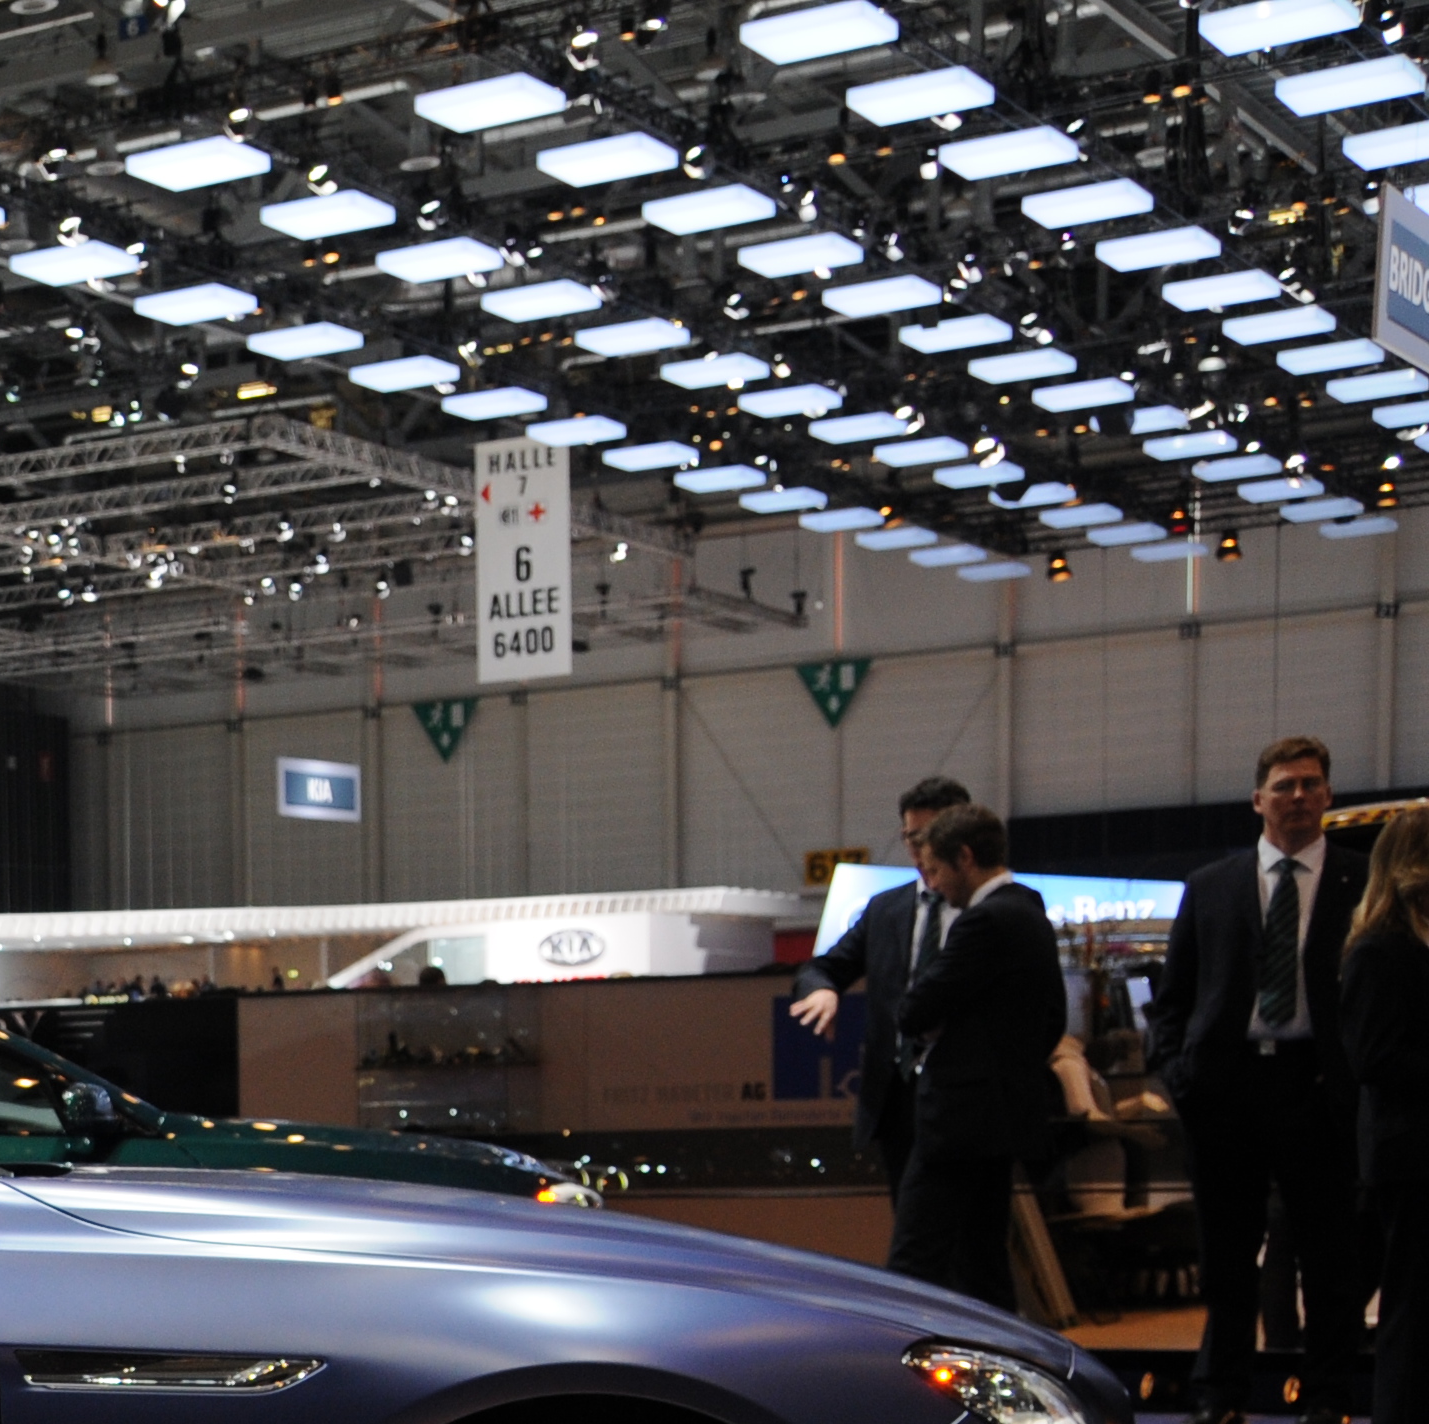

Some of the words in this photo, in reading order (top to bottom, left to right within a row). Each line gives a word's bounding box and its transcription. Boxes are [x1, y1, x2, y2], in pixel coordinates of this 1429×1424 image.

[488, 446, 557, 474] HALLE
[517, 476, 528, 496] 7
[515, 546, 533, 583] 6
[490, 587, 560, 621] ALLEE
[494, 625, 554, 658] 6400
